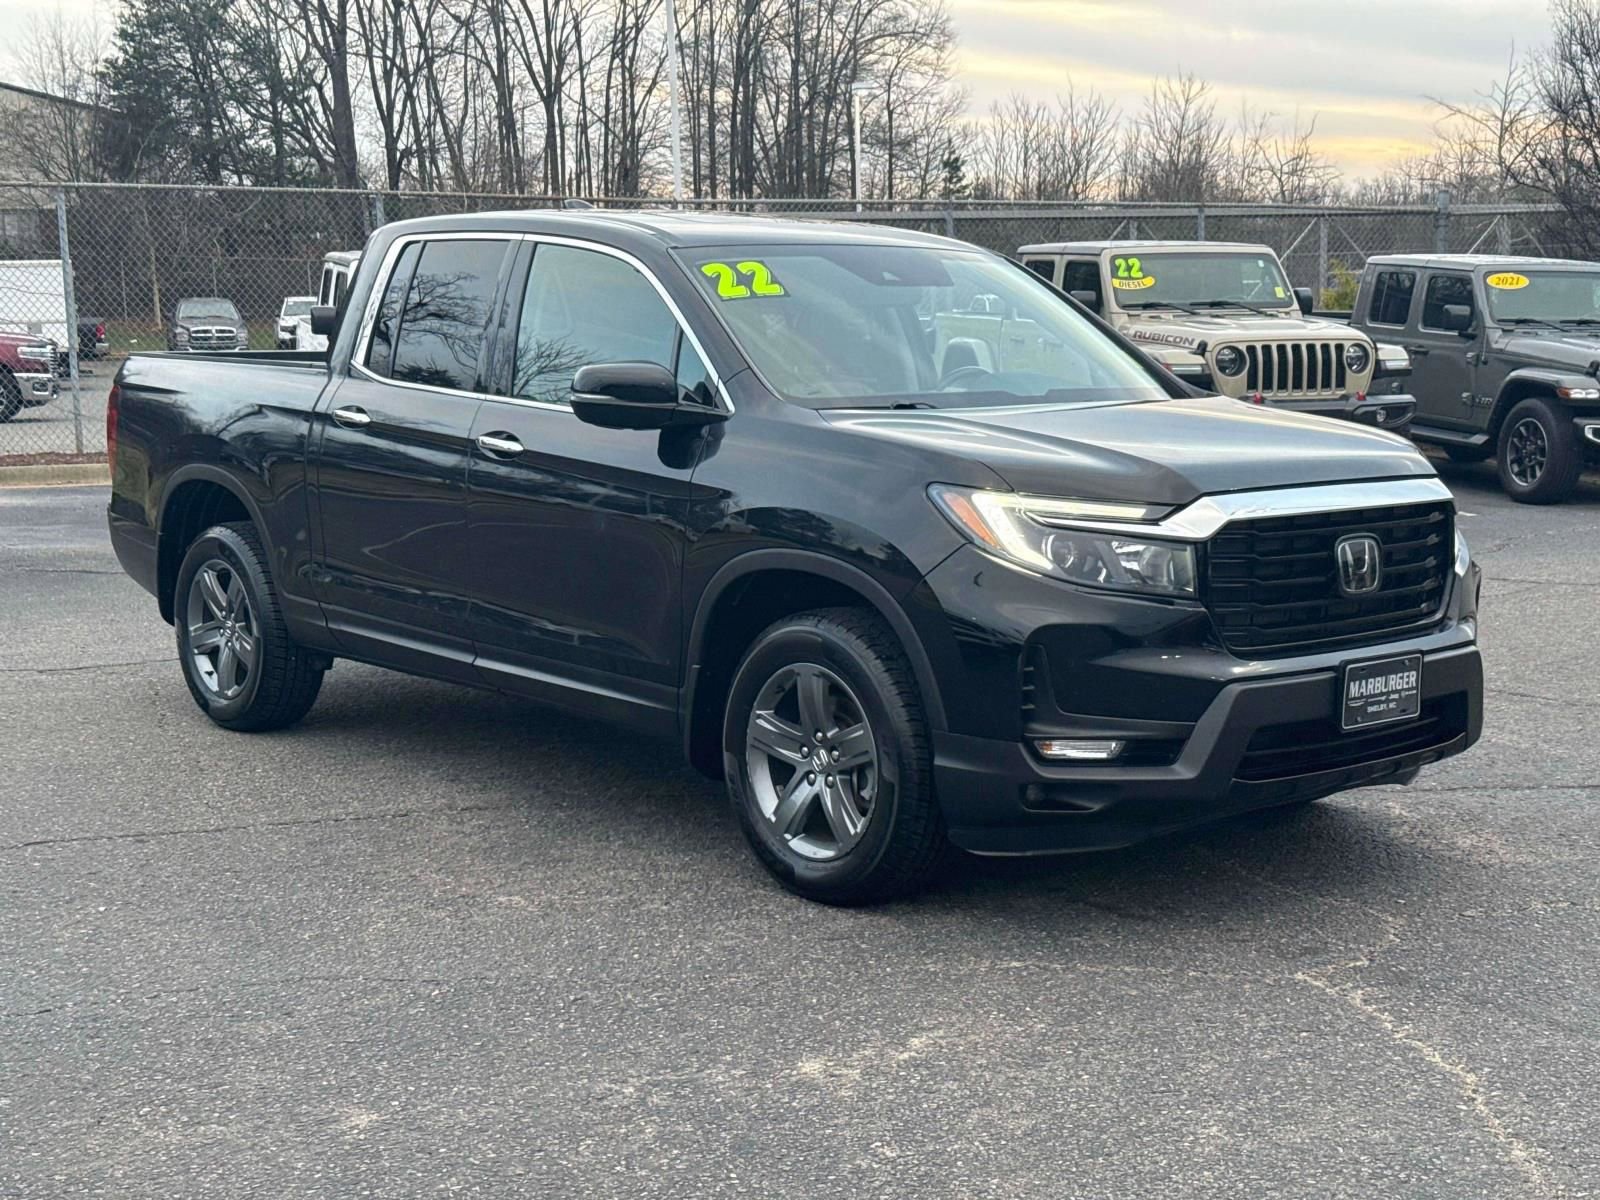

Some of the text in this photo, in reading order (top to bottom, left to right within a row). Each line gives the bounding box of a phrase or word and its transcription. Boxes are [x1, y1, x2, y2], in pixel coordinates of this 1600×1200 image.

[1114, 257, 1144, 278] 22
[700, 260, 785, 300] 22
[1118, 279, 1147, 289] DIESEL
[1495, 276, 1521, 286] 2021
[1133, 330, 1195, 346] RUBICON
[1348, 670, 1417, 698] MARBURGER
